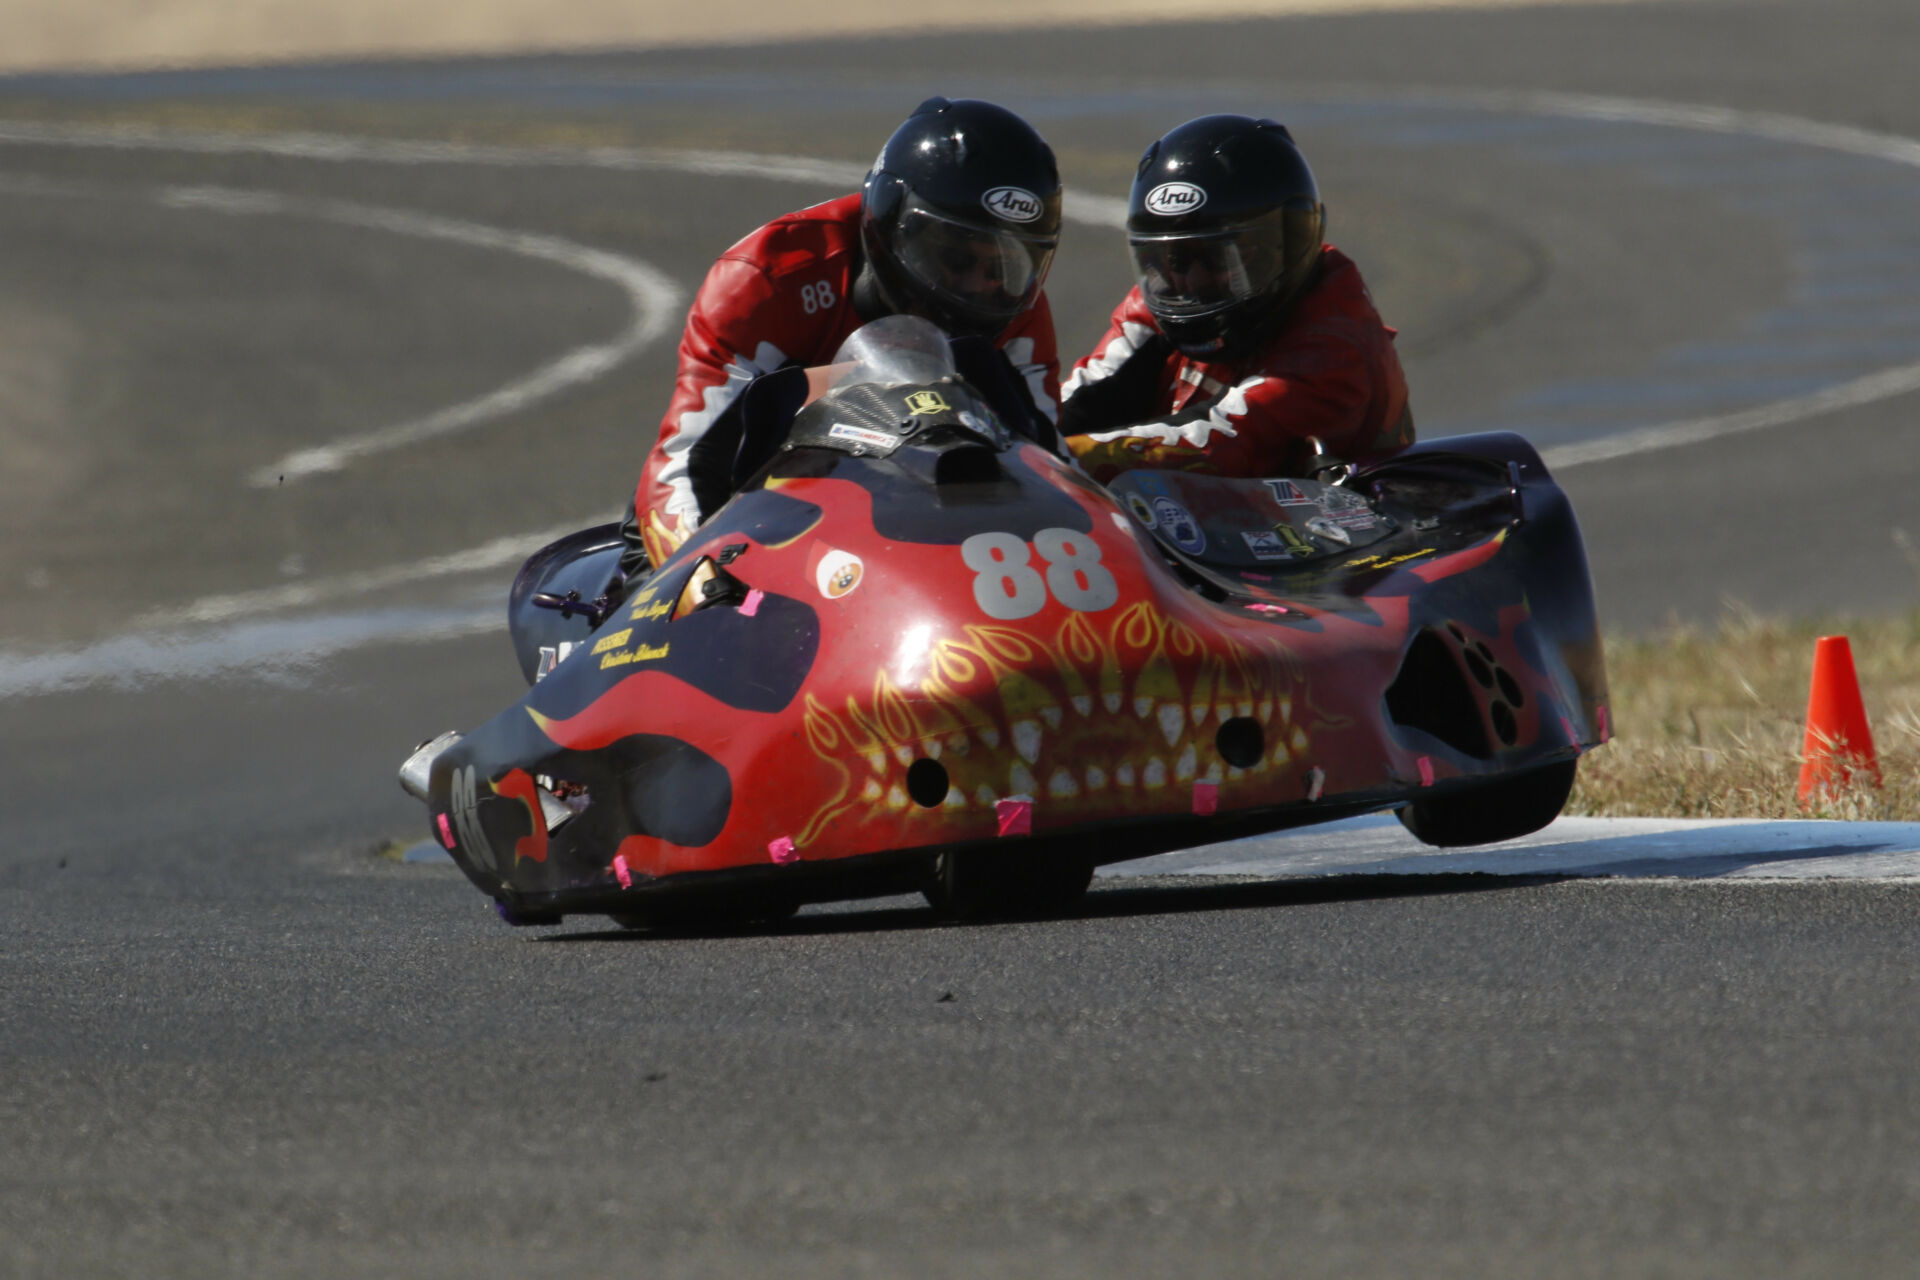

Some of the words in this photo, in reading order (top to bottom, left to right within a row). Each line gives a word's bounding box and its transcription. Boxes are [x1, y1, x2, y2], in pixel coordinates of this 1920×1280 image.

[988, 190, 1037, 215] Arai
[1151, 186, 1197, 206] Arai
[801, 280, 836, 315] 88
[961, 527, 1119, 620] 88
